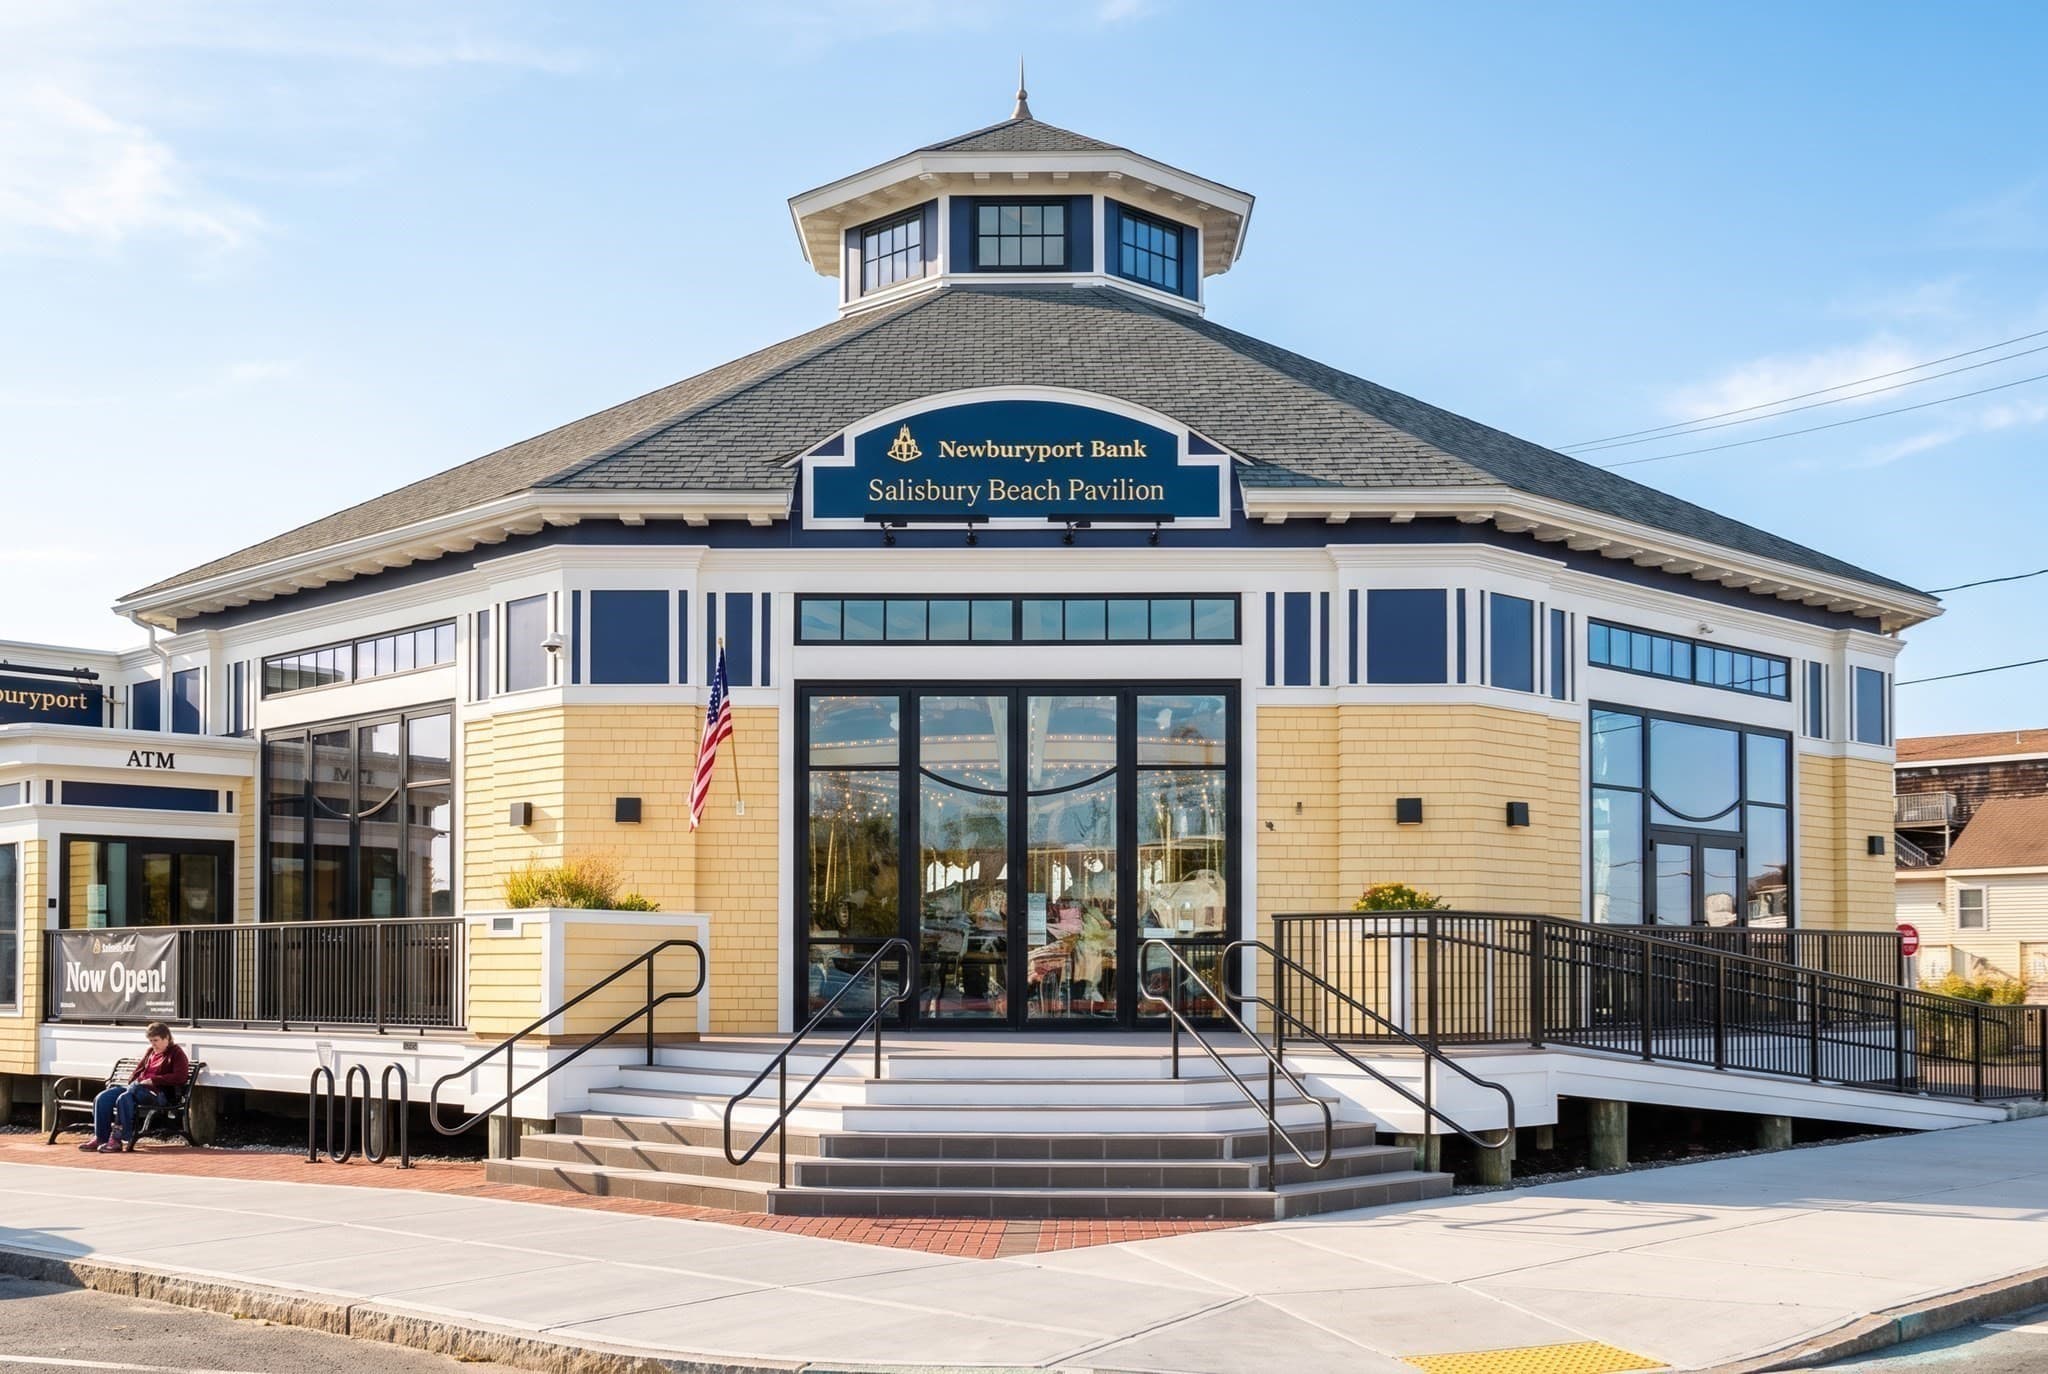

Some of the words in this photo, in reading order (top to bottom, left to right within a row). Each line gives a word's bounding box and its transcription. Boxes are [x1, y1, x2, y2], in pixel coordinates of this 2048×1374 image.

[938, 439, 1083, 463] Newburyport
[1091, 439, 1147, 458] Bank
[868, 478, 981, 507] Salisbury
[988, 478, 1060, 501] Beach
[1068, 478, 1164, 501] Pavilion
[126, 750, 176, 769] ATM
[65, 961, 106, 993] Now
[109, 960, 167, 1002] Open!
